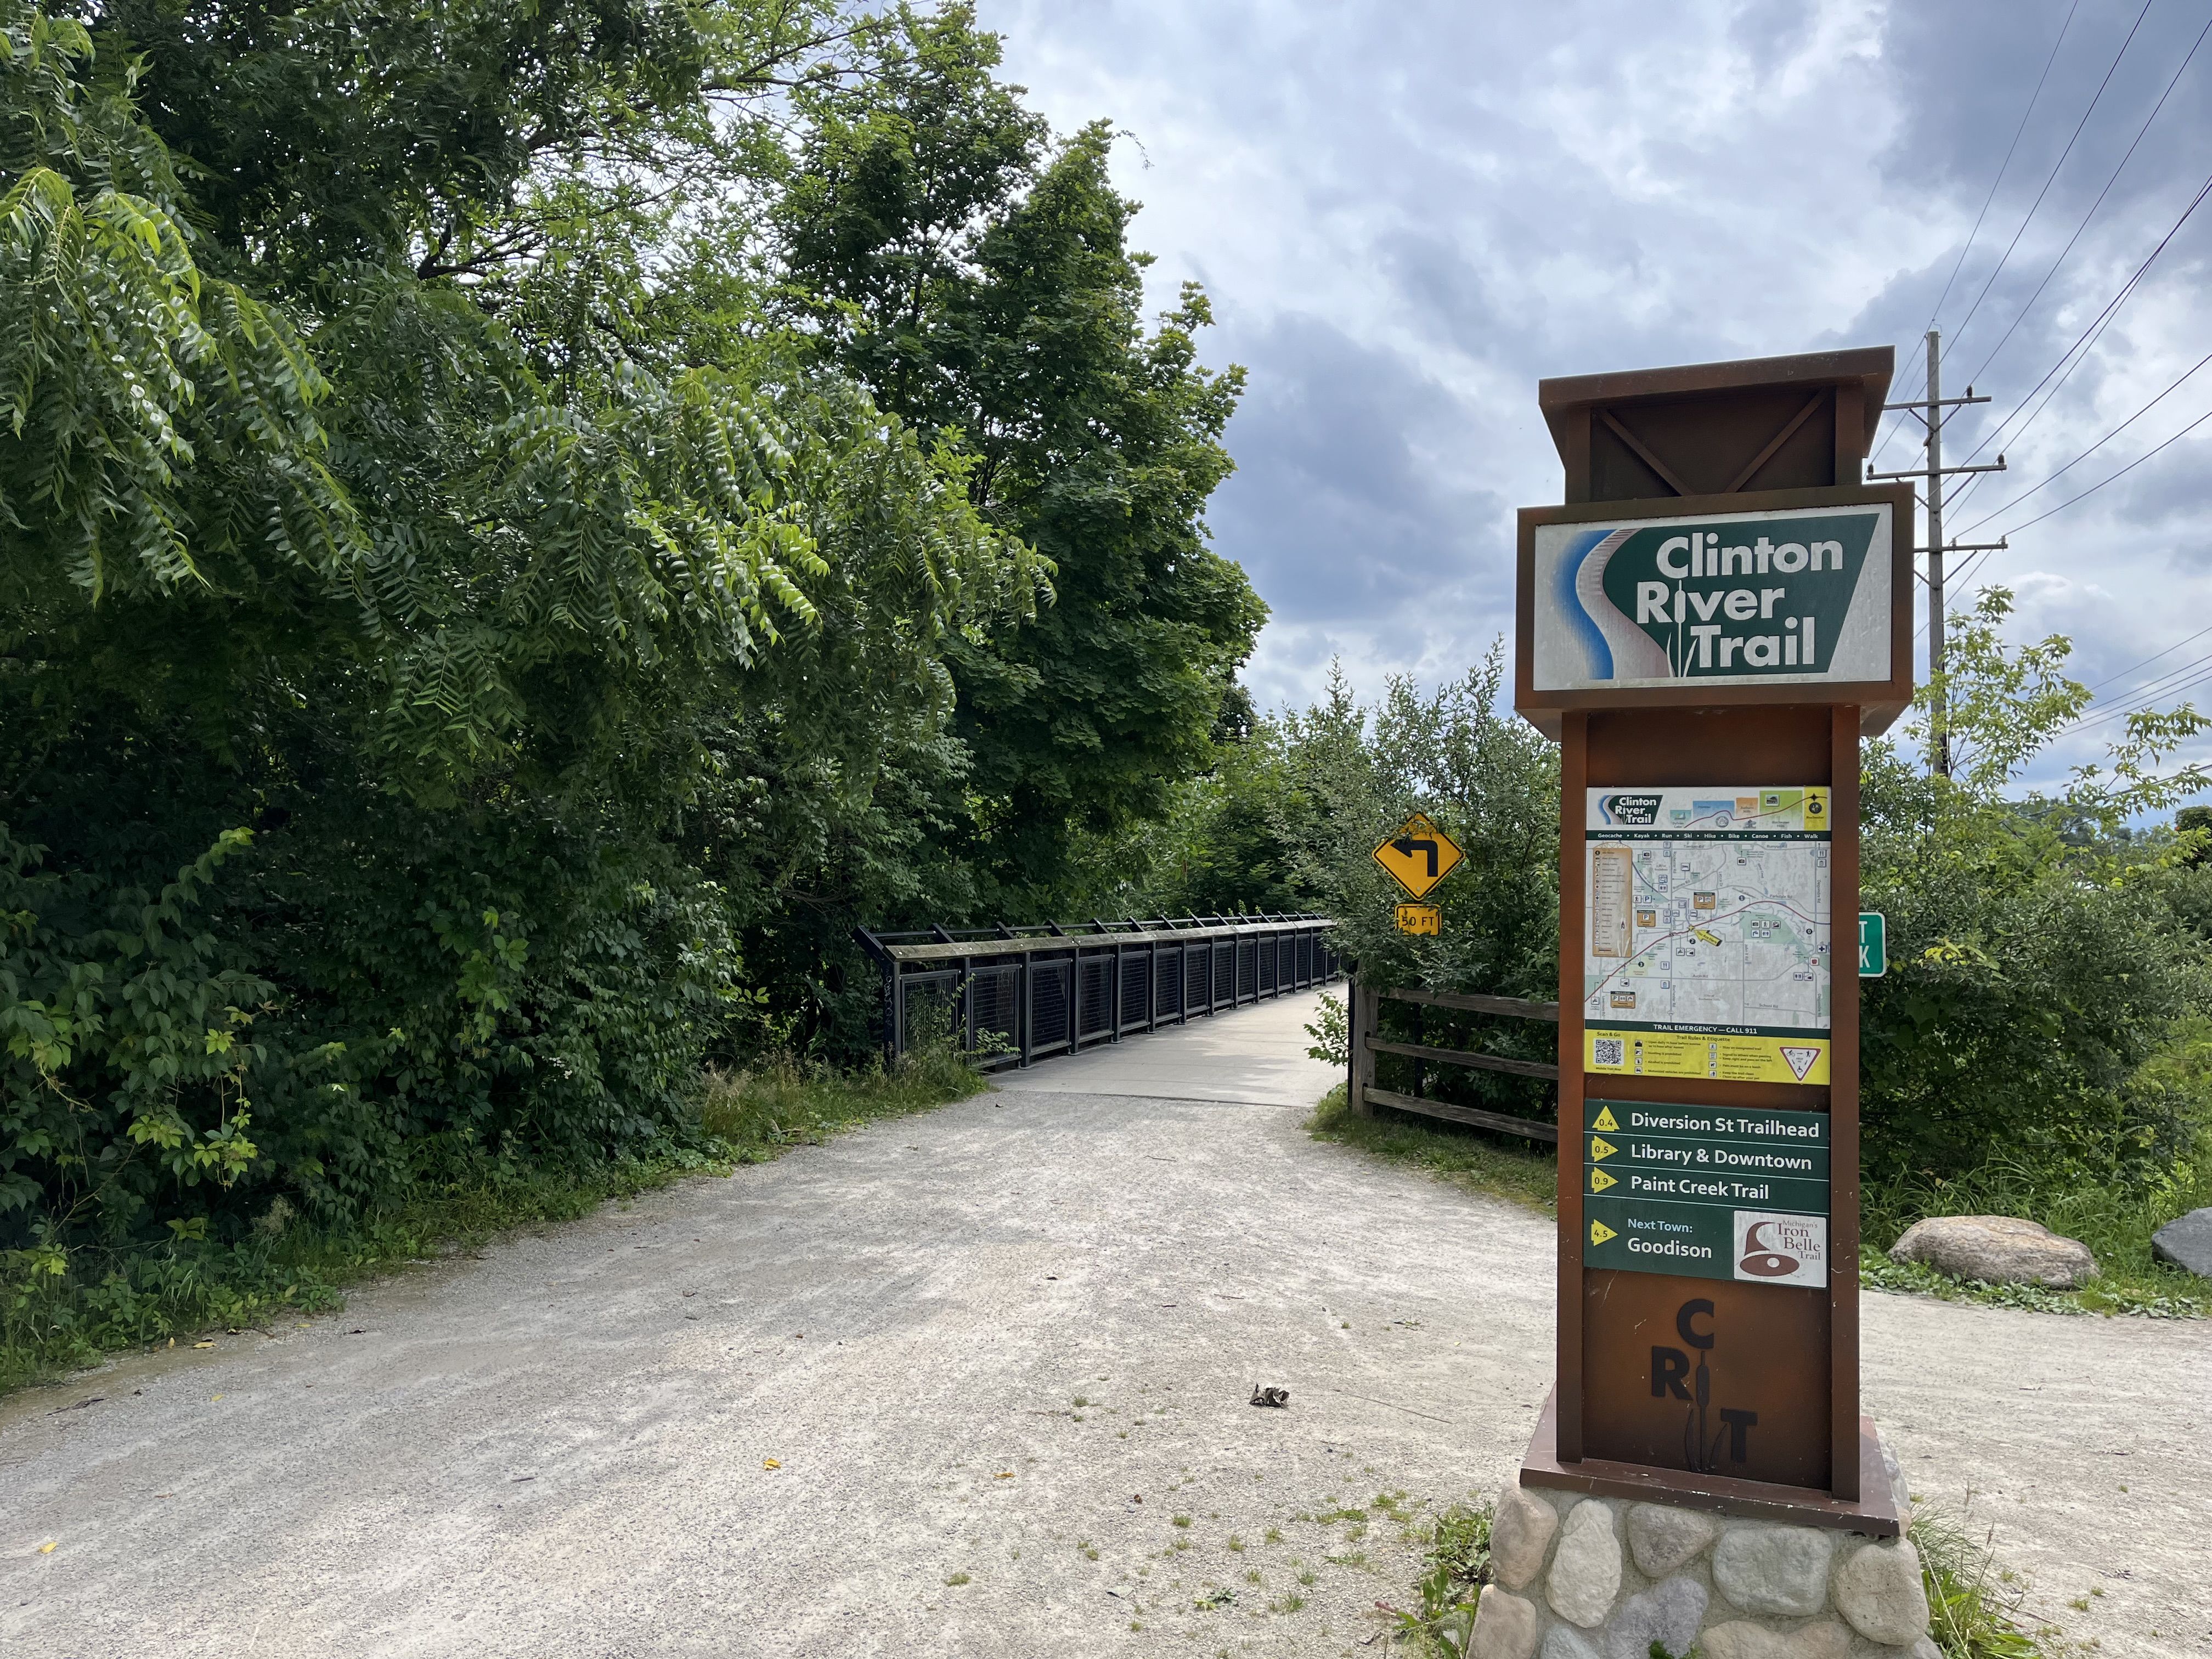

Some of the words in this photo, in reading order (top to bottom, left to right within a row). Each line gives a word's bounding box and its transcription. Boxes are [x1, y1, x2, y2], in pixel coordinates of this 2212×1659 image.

[1656, 532, 1844, 579] Clinton
[1637, 580, 1786, 624] River
[1689, 616, 1816, 668] Trail
[1615, 805, 1645, 815] River
[1618, 796, 1657, 806] Clinton
[1626, 813, 1651, 824] Trail
[1402, 916, 1417, 926] 50
[1421, 917, 1435, 926] FT
[1599, 1118, 1613, 1127] 0.4
[1631, 1113, 1711, 1131] Diversion
[1715, 1117, 1734, 1133] St
[1737, 1119, 1819, 1138] Trailhead
[1594, 1145, 1609, 1154] 0.5
[1631, 1144, 1692, 1165] Library
[1696, 1148, 1709, 1163] &
[1714, 1150, 1813, 1170] Downtown
[1594, 1176, 1609, 1186] 0.9
[1630, 1175, 1676, 1193] Paint
[1679, 1179, 1729, 1197] Creek
[1731, 1183, 1769, 1200] Trail
[1628, 1218, 1656, 1231] Next
[1657, 1221, 1693, 1233] Town:
[1777, 1223, 1810, 1238] Iron
[1783, 1220, 1818, 1229] Michigan's
[1593, 1229, 1609, 1238] 4.5
[1627, 1238, 1712, 1259] Goodison
[1784, 1237, 1821, 1252] Belle
[1798, 1250, 1821, 1260] Trail
[1677, 1298, 1714, 1350] C
[1651, 1345, 1694, 1401] R
[1720, 1408, 1758, 1463] T
